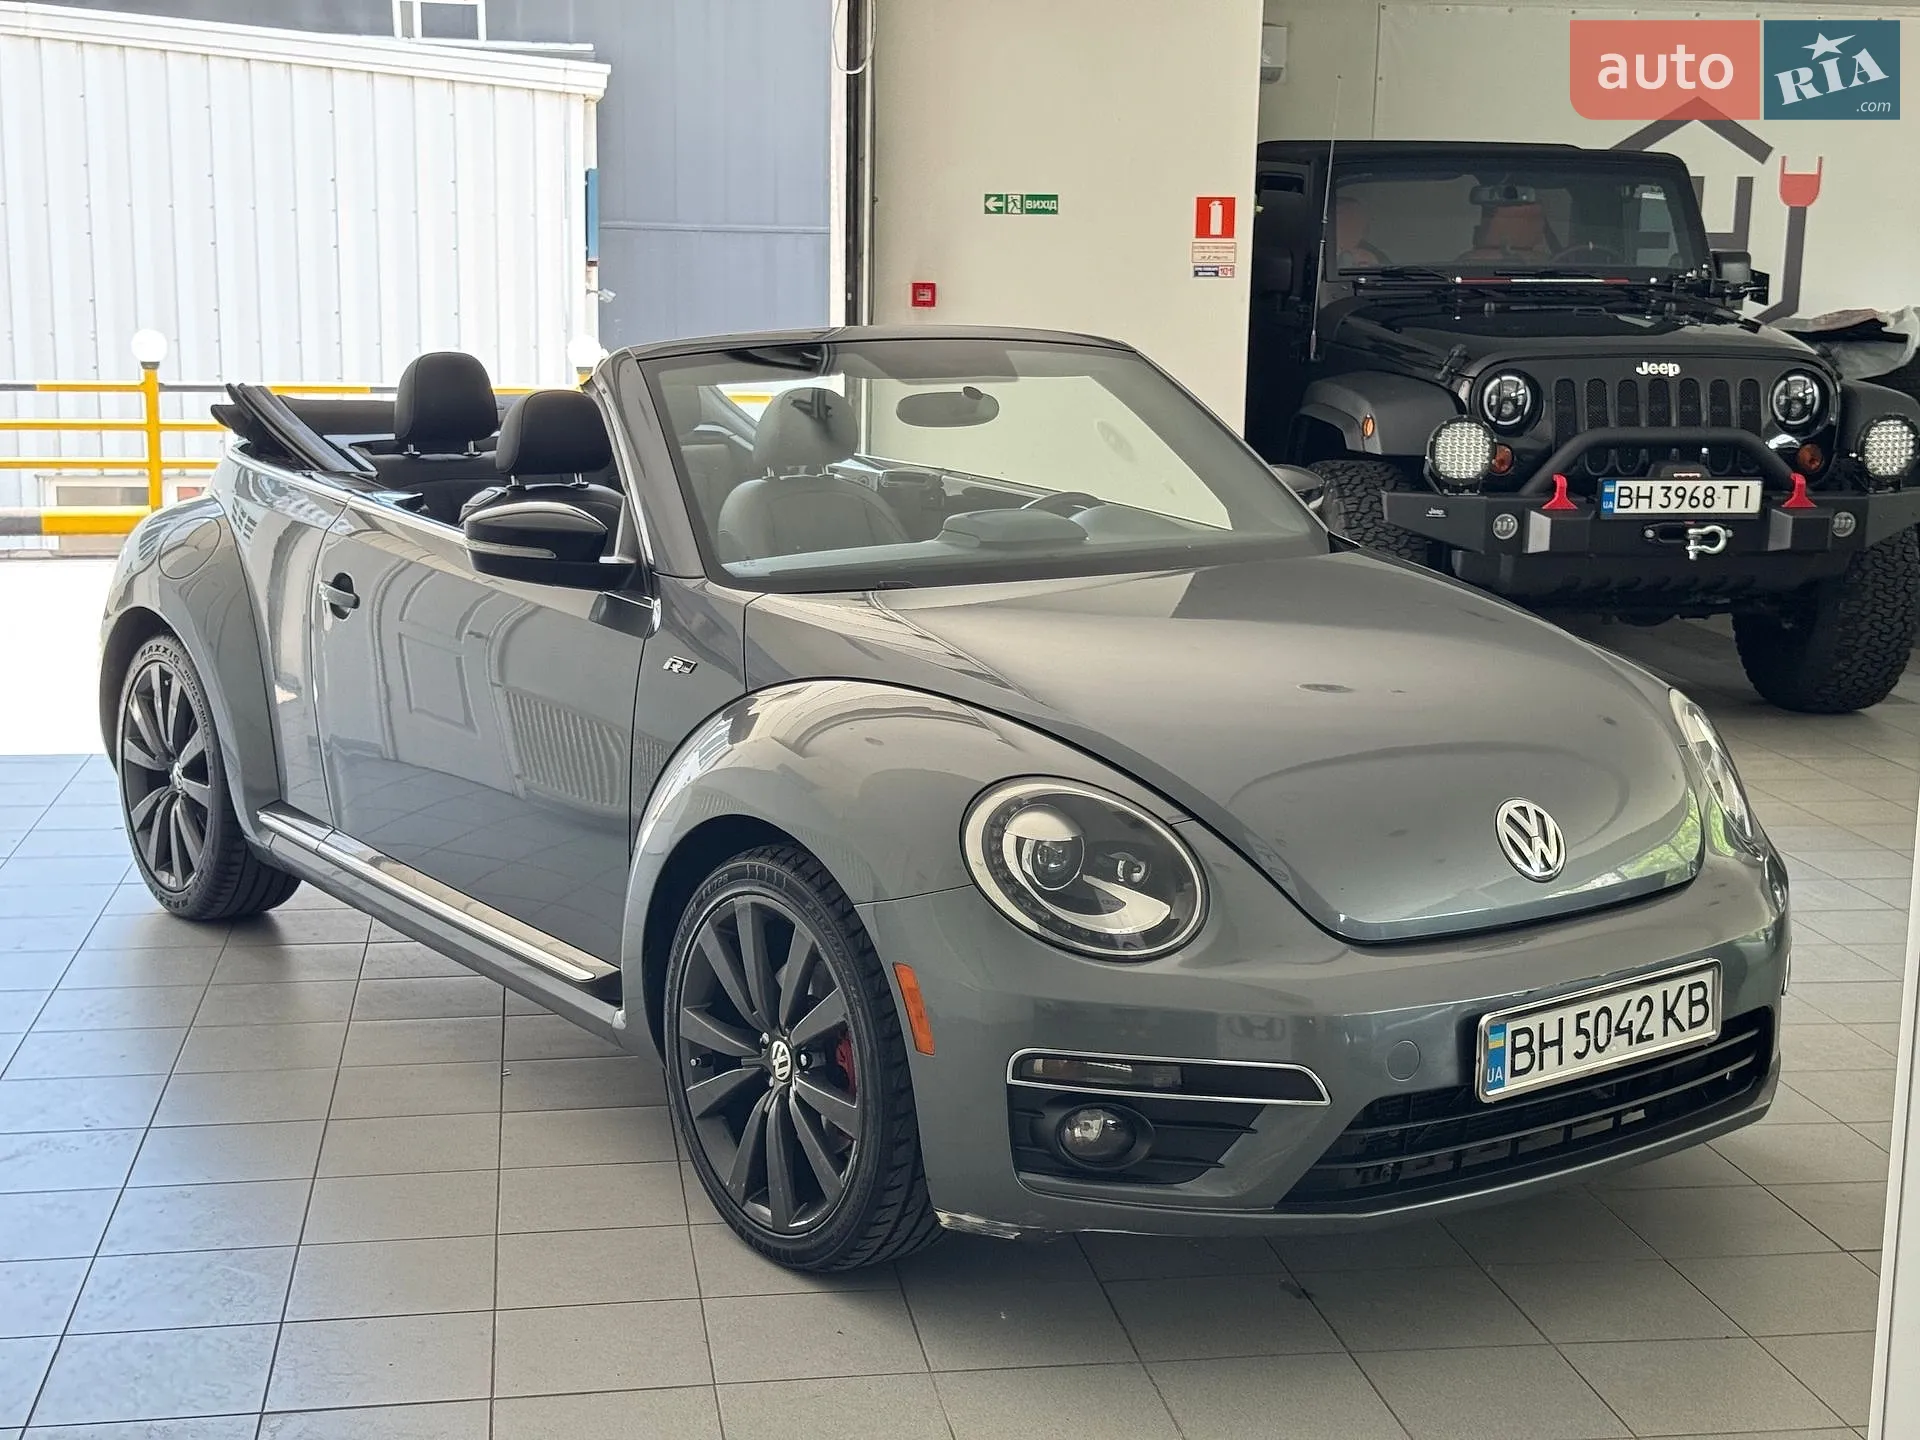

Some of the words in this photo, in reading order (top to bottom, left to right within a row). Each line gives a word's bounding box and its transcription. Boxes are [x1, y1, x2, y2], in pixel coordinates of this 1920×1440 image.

[1025, 200, 1057, 211] ВИХІД
[1635, 361, 1681, 377] Jeep
[1602, 501, 1614, 509] UA
[1616, 486, 1653, 509] BH
[1658, 485, 1716, 509] 3968
[1723, 485, 1751, 509] TI
[1509, 1016, 1564, 1079] BH
[1573, 994, 1655, 1061] 5042
[1662, 980, 1710, 1038] KB
[1486, 1067, 1504, 1084] UA
